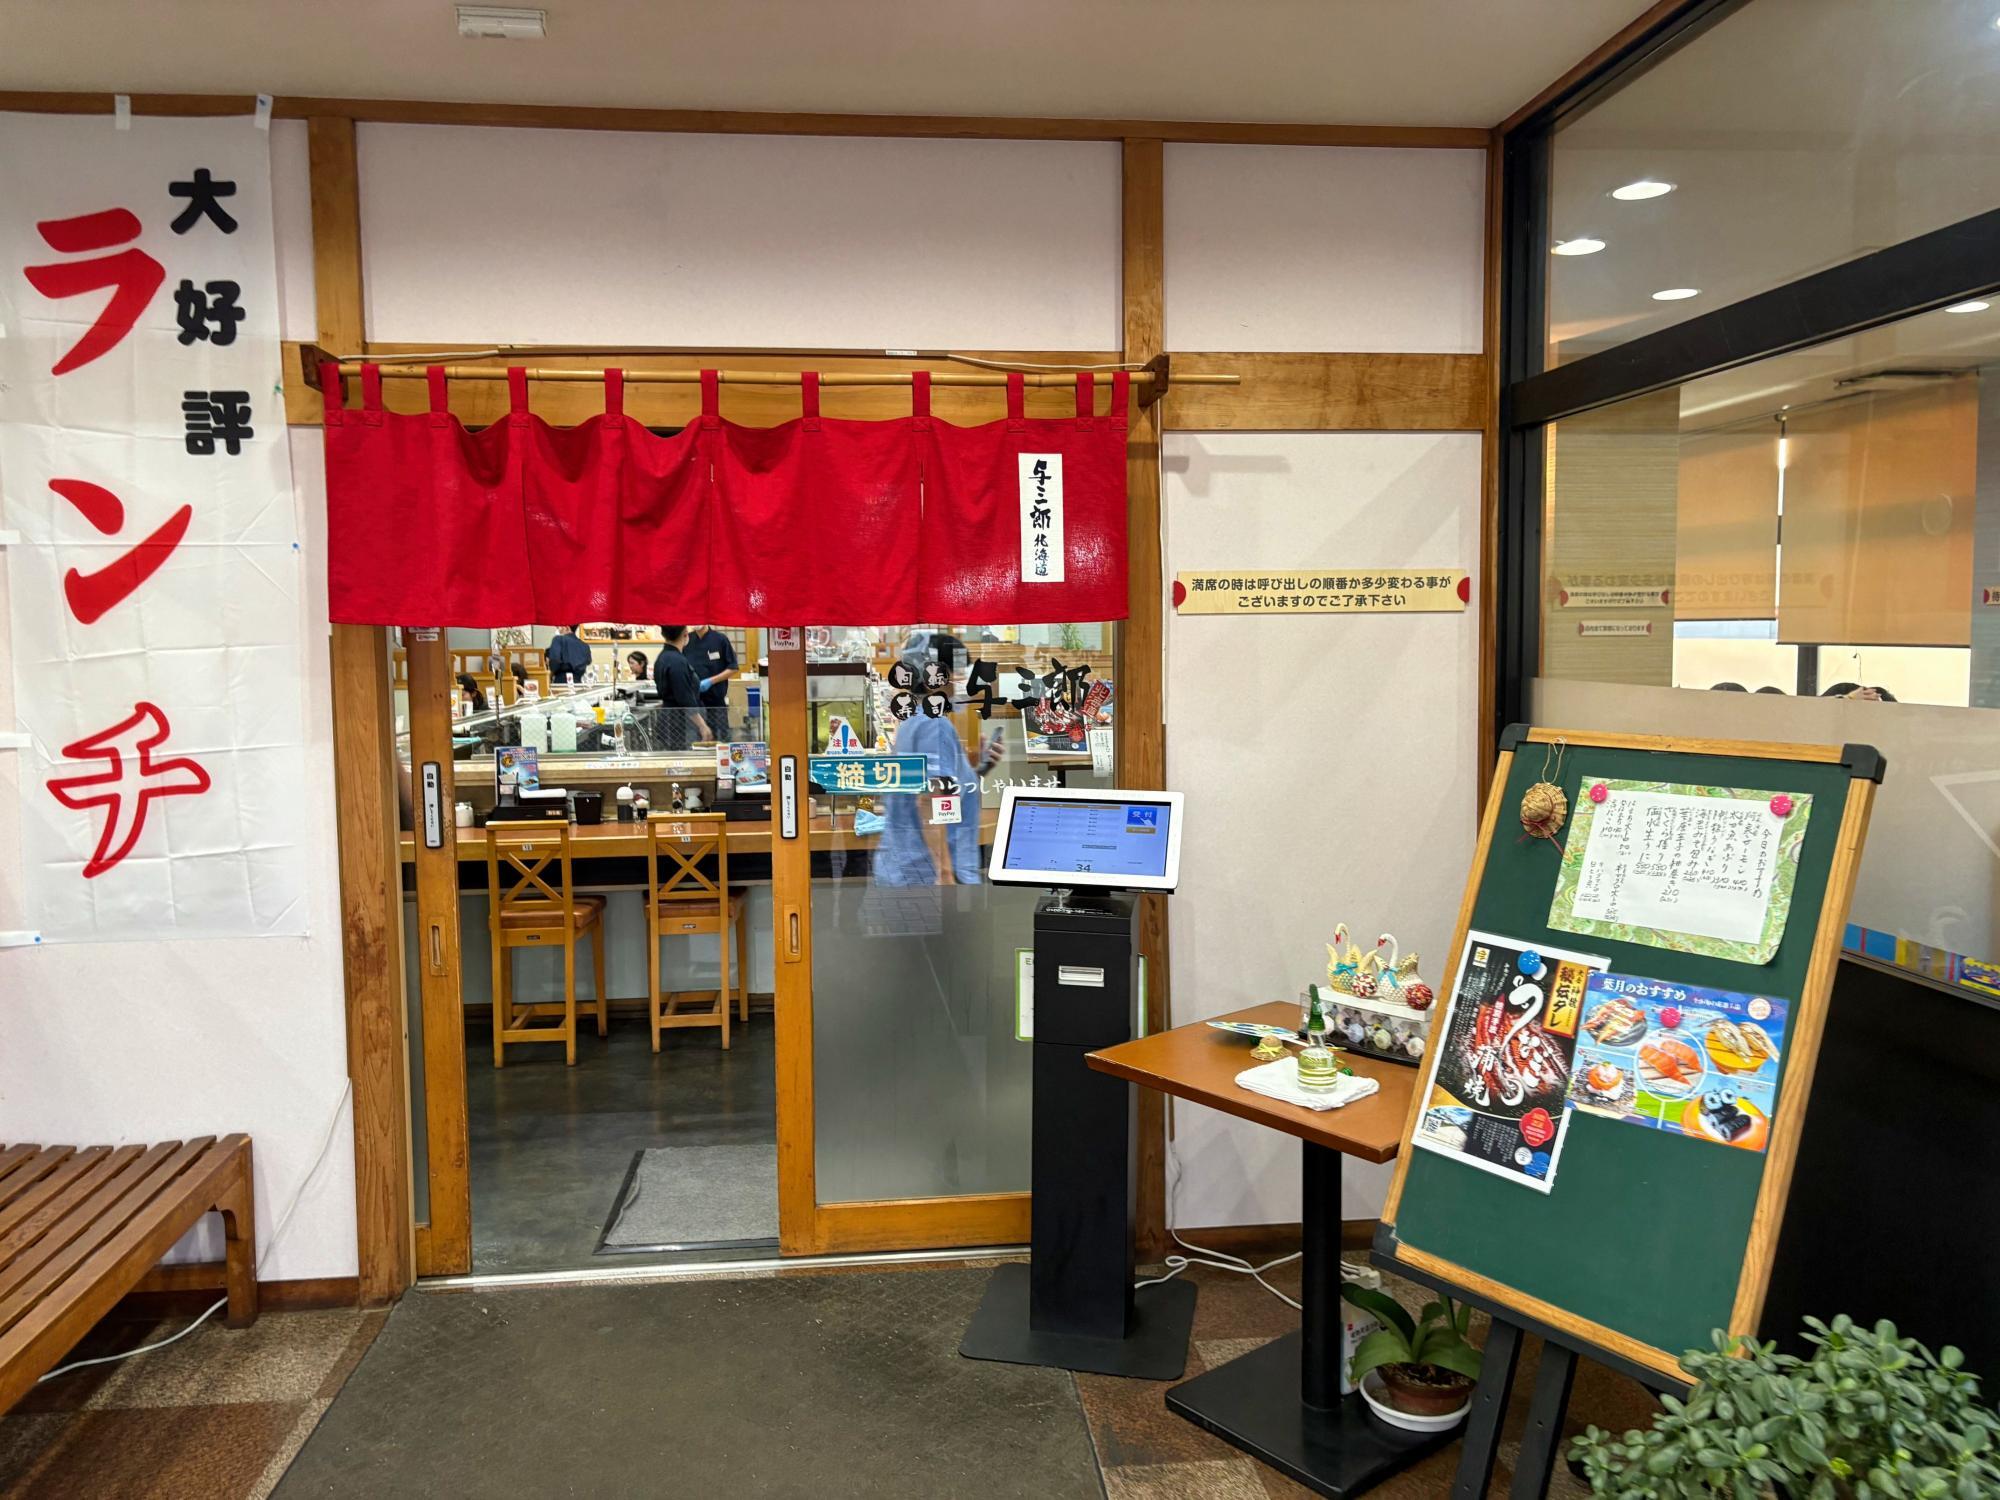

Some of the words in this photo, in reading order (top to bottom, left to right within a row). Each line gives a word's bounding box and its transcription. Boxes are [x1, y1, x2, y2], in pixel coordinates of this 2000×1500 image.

[168, 166, 254, 456] 大好評
[24, 207, 211, 879] ランチ
[1034, 533, 1048, 577] 北海道
[1238, 594, 1406, 608] ございますのでご了承下さい
[890, 661, 949, 689] 回転
[892, 692, 949, 720] 寿司
[835, 761, 901, 789] 締切
[927, 774, 1062, 796] いらっしゃいませ
[1075, 863, 1091, 873] 34
[1601, 977, 1687, 1002] 葉月のおすすめ
